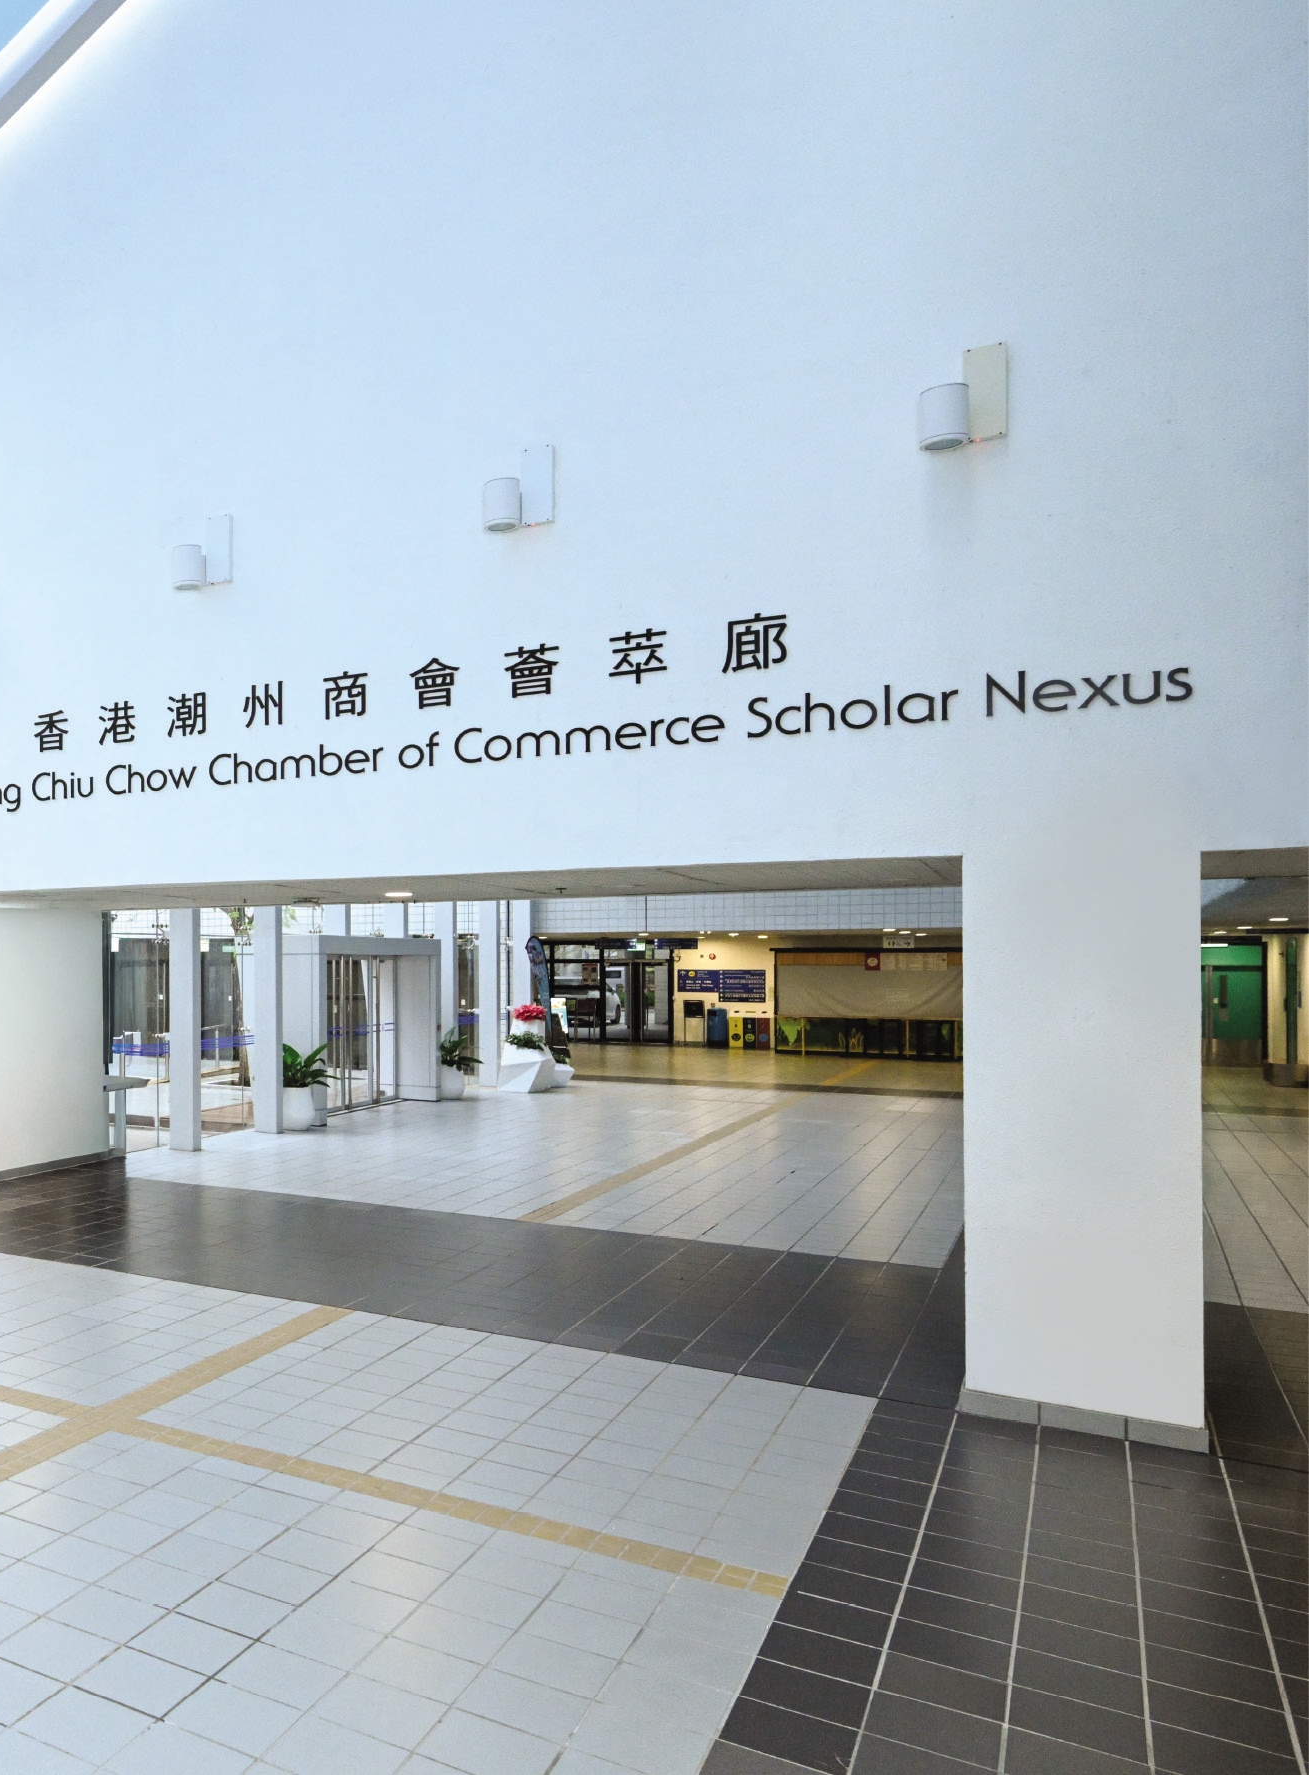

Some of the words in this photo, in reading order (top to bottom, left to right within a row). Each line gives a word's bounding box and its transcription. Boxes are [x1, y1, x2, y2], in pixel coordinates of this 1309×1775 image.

[31, 770, 94, 802] Chiu
[105, 763, 197, 796] Chow
[208, 743, 384, 786] Chamber
[398, 730, 440, 770] of
[453, 714, 726, 764] Commerce
[747, 684, 959, 739] Scholar
[985, 666, 1194, 718] Nexus
[33, 612, 788, 753] 香港潮州商會薈萃廊
